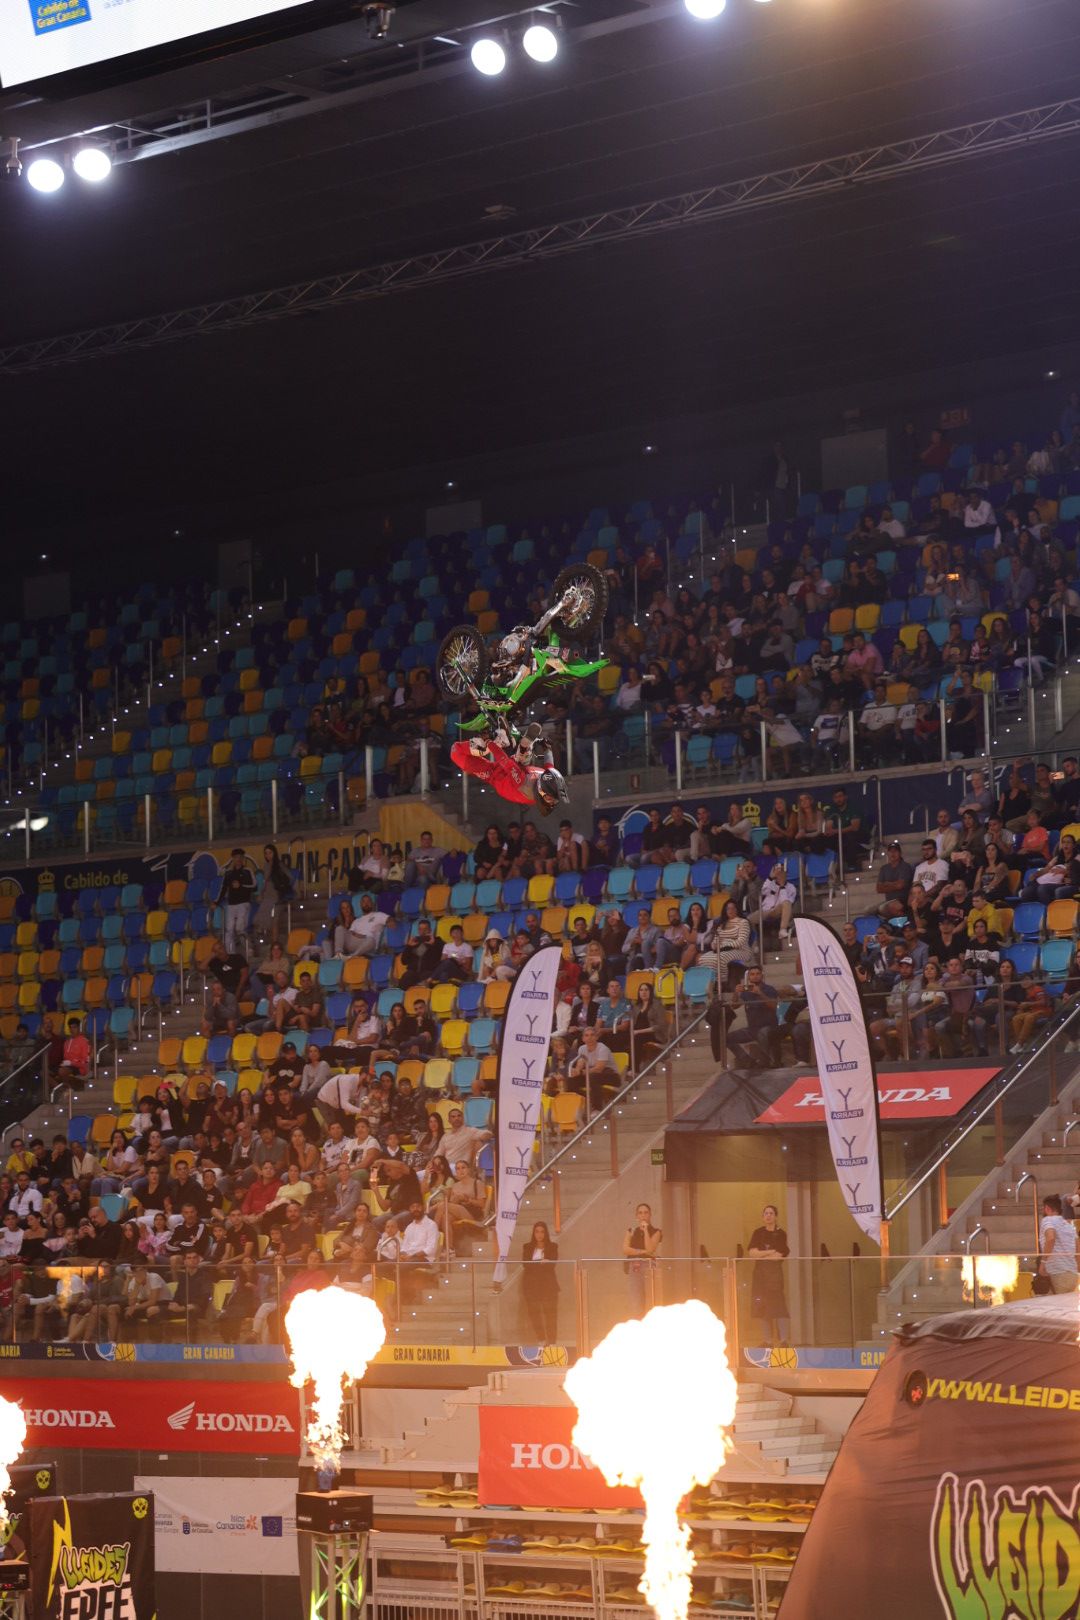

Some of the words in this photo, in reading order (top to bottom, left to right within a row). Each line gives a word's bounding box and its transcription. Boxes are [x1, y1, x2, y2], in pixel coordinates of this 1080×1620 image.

[37, 16, 55, 28] Gran
[64, 871, 111, 890] Cabildo
[112, 869, 129, 885] de
[517, 1034, 544, 1044] YBARRA
[794, 1087, 953, 1107] HNDA
[183, 1347, 202, 1360] GRAN
[204, 1347, 235, 1360] CANARIA
[394, 1348, 414, 1360] GRAN
[417, 1348, 450, 1361] CANARIA
[24, 1409, 116, 1428] HONDA
[196, 1413, 295, 1432] HONDA
[511, 1443, 594, 1470] HON
[230, 1514, 246, 1522] Islas
[216, 1521, 246, 1530] Canarias
